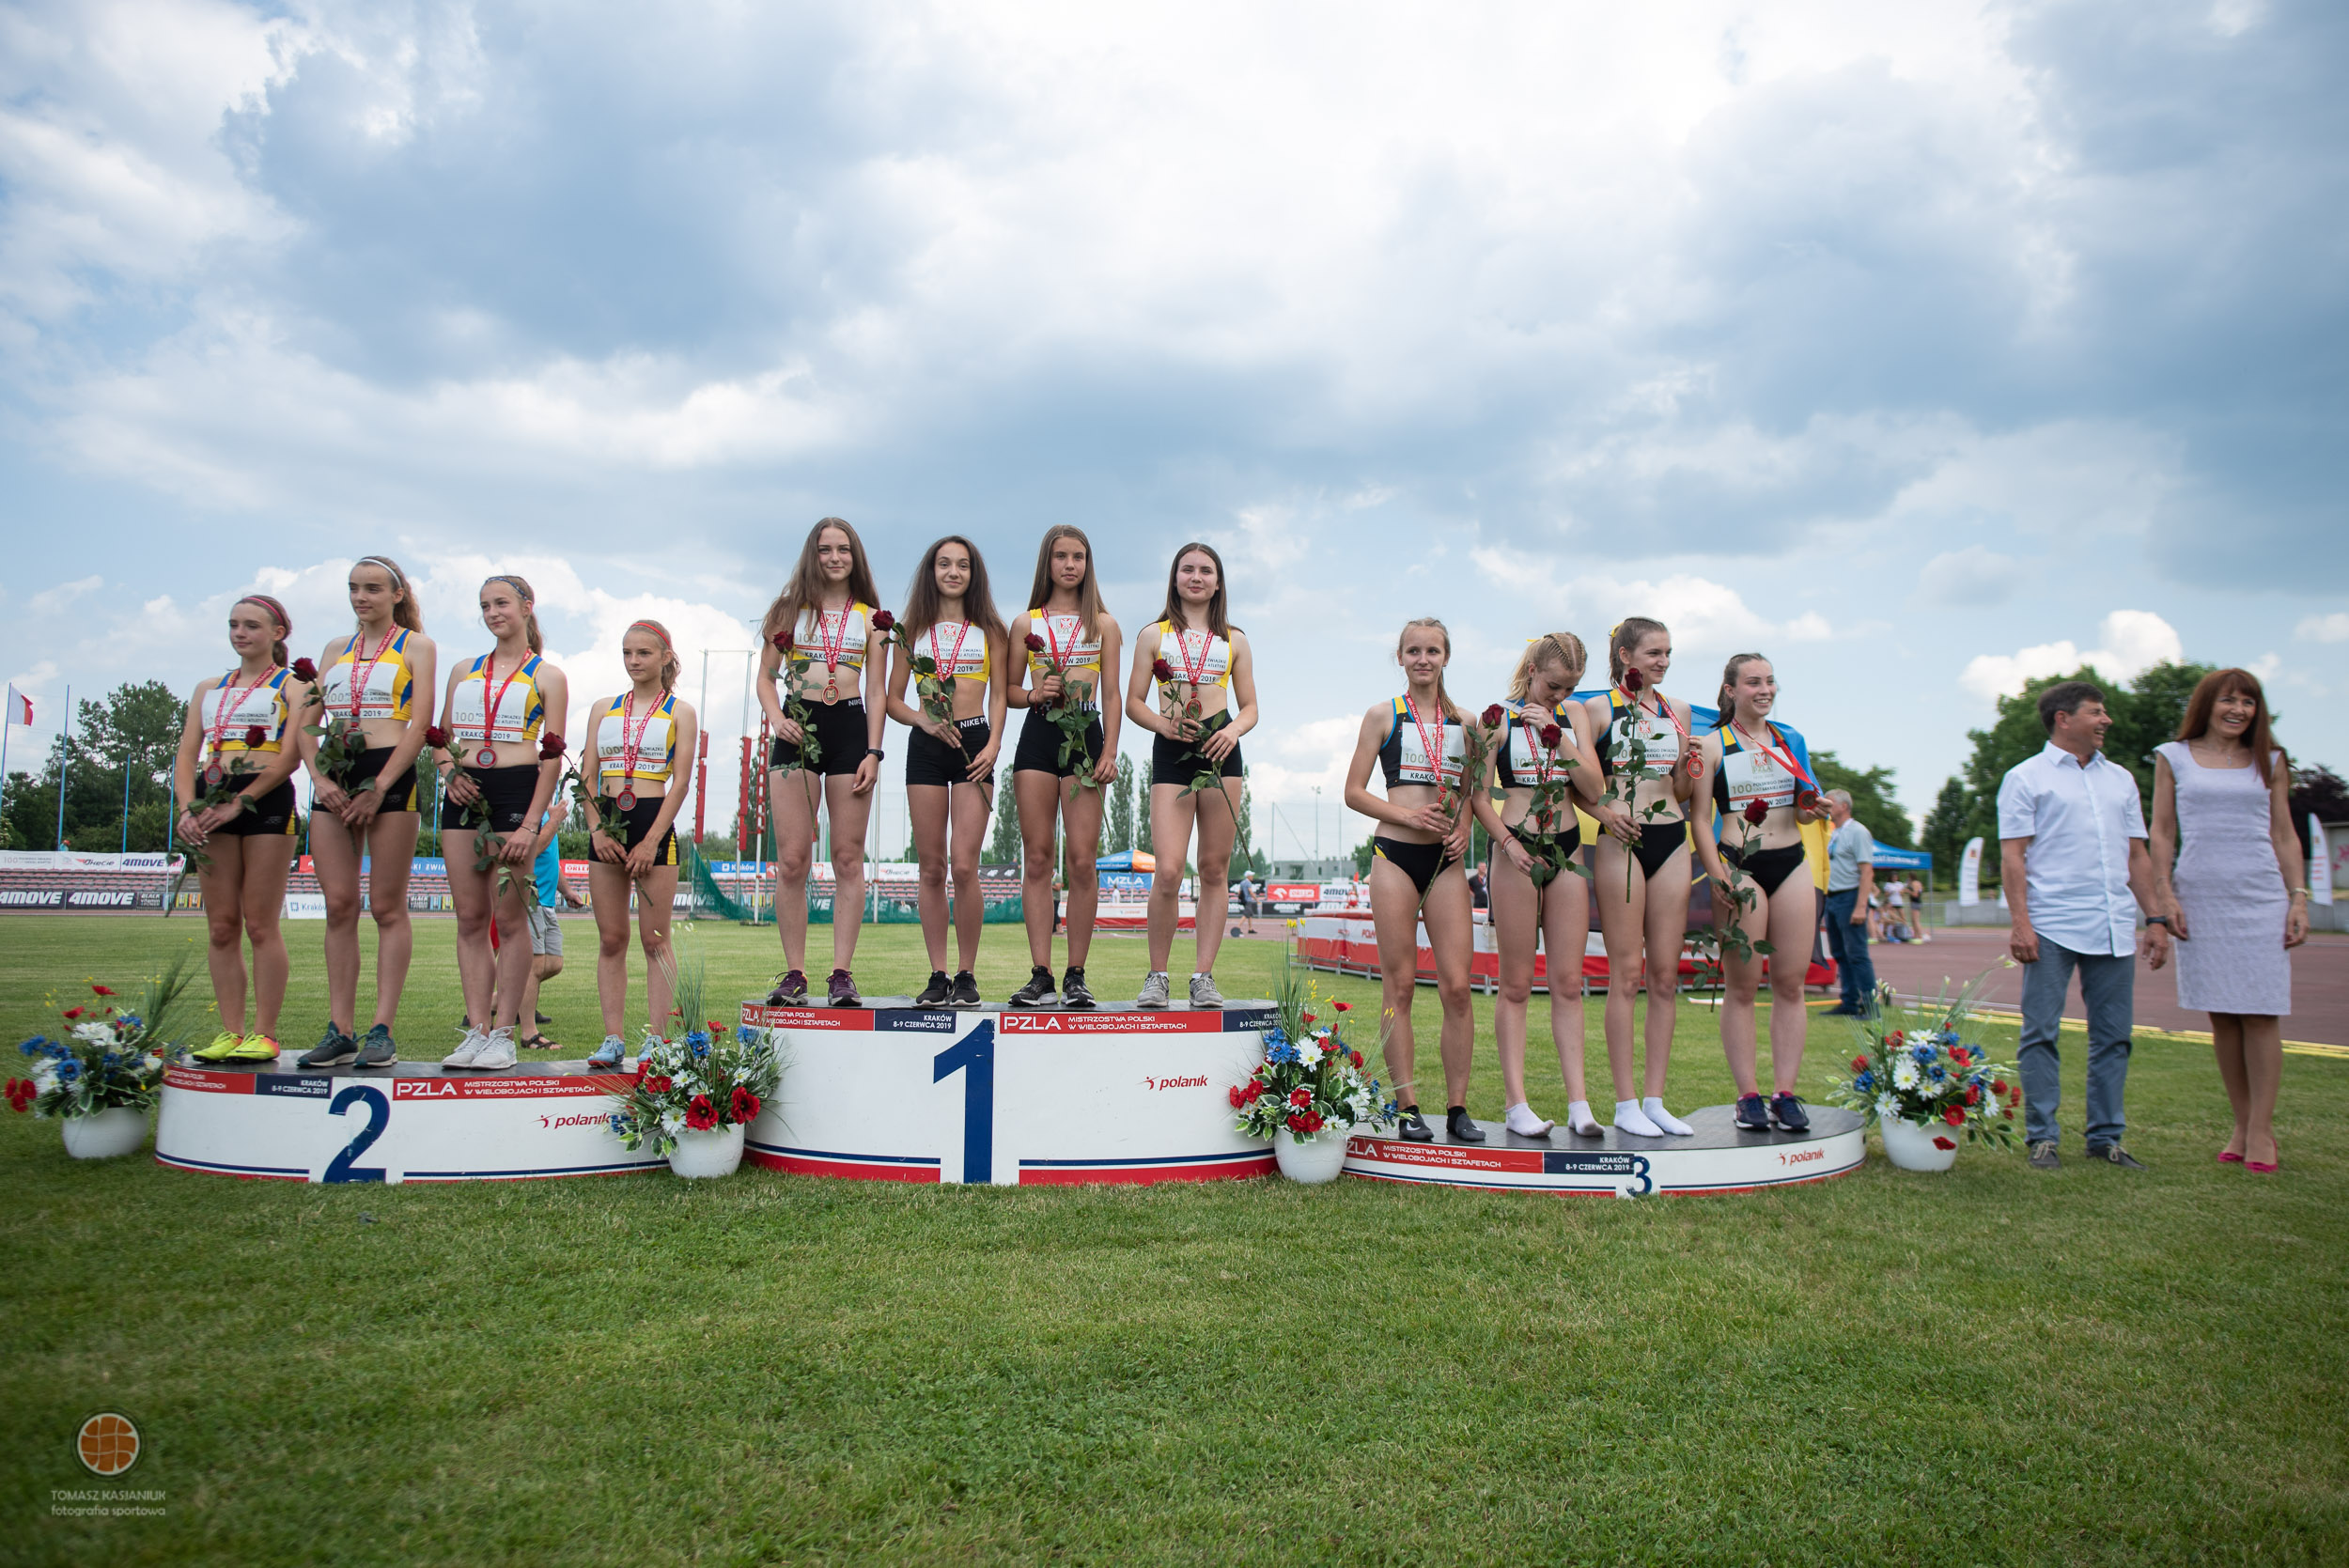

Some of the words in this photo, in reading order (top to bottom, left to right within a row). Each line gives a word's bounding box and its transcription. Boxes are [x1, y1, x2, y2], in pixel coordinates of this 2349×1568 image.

[804, 651, 828, 660] KRAKÓ
[455, 712, 474, 722] 100
[960, 718, 980, 729] NIKE
[460, 730, 487, 738] KRAKÓ
[601, 746, 620, 755] 100
[1405, 753, 1424, 764] 100
[1410, 772, 1437, 782] KRAKÓ
[1731, 784, 1752, 795] 100
[122, 859, 165, 867] 4MOVE
[1107, 876, 1144, 885] MZLA
[1323, 888, 1351, 896] 4MOV
[0, 891, 63, 905] 4MOVE
[69, 892, 135, 905] 4MOVE
[924, 1013, 952, 1023] KRAKÓW
[1003, 1016, 1062, 1031] PZLA
[301, 1079, 329, 1088] KRAKÓW
[1159, 1075, 1208, 1091] polanik
[396, 1082, 458, 1096] PZLA
[933, 1018, 995, 1184] 1
[323, 1084, 390, 1184] 2
[1346, 1141, 1378, 1157] ZLA
[1382, 1145, 1438, 1156] MISTRZOSTWA
[1392, 1153, 1446, 1165] WIELOBOJACH
[1451, 1158, 1501, 1169] SZTAFETACH
[1599, 1155, 1630, 1164] KRAKÓW
[1790, 1148, 1826, 1167] polanik
[1626, 1156, 1653, 1198] 3
